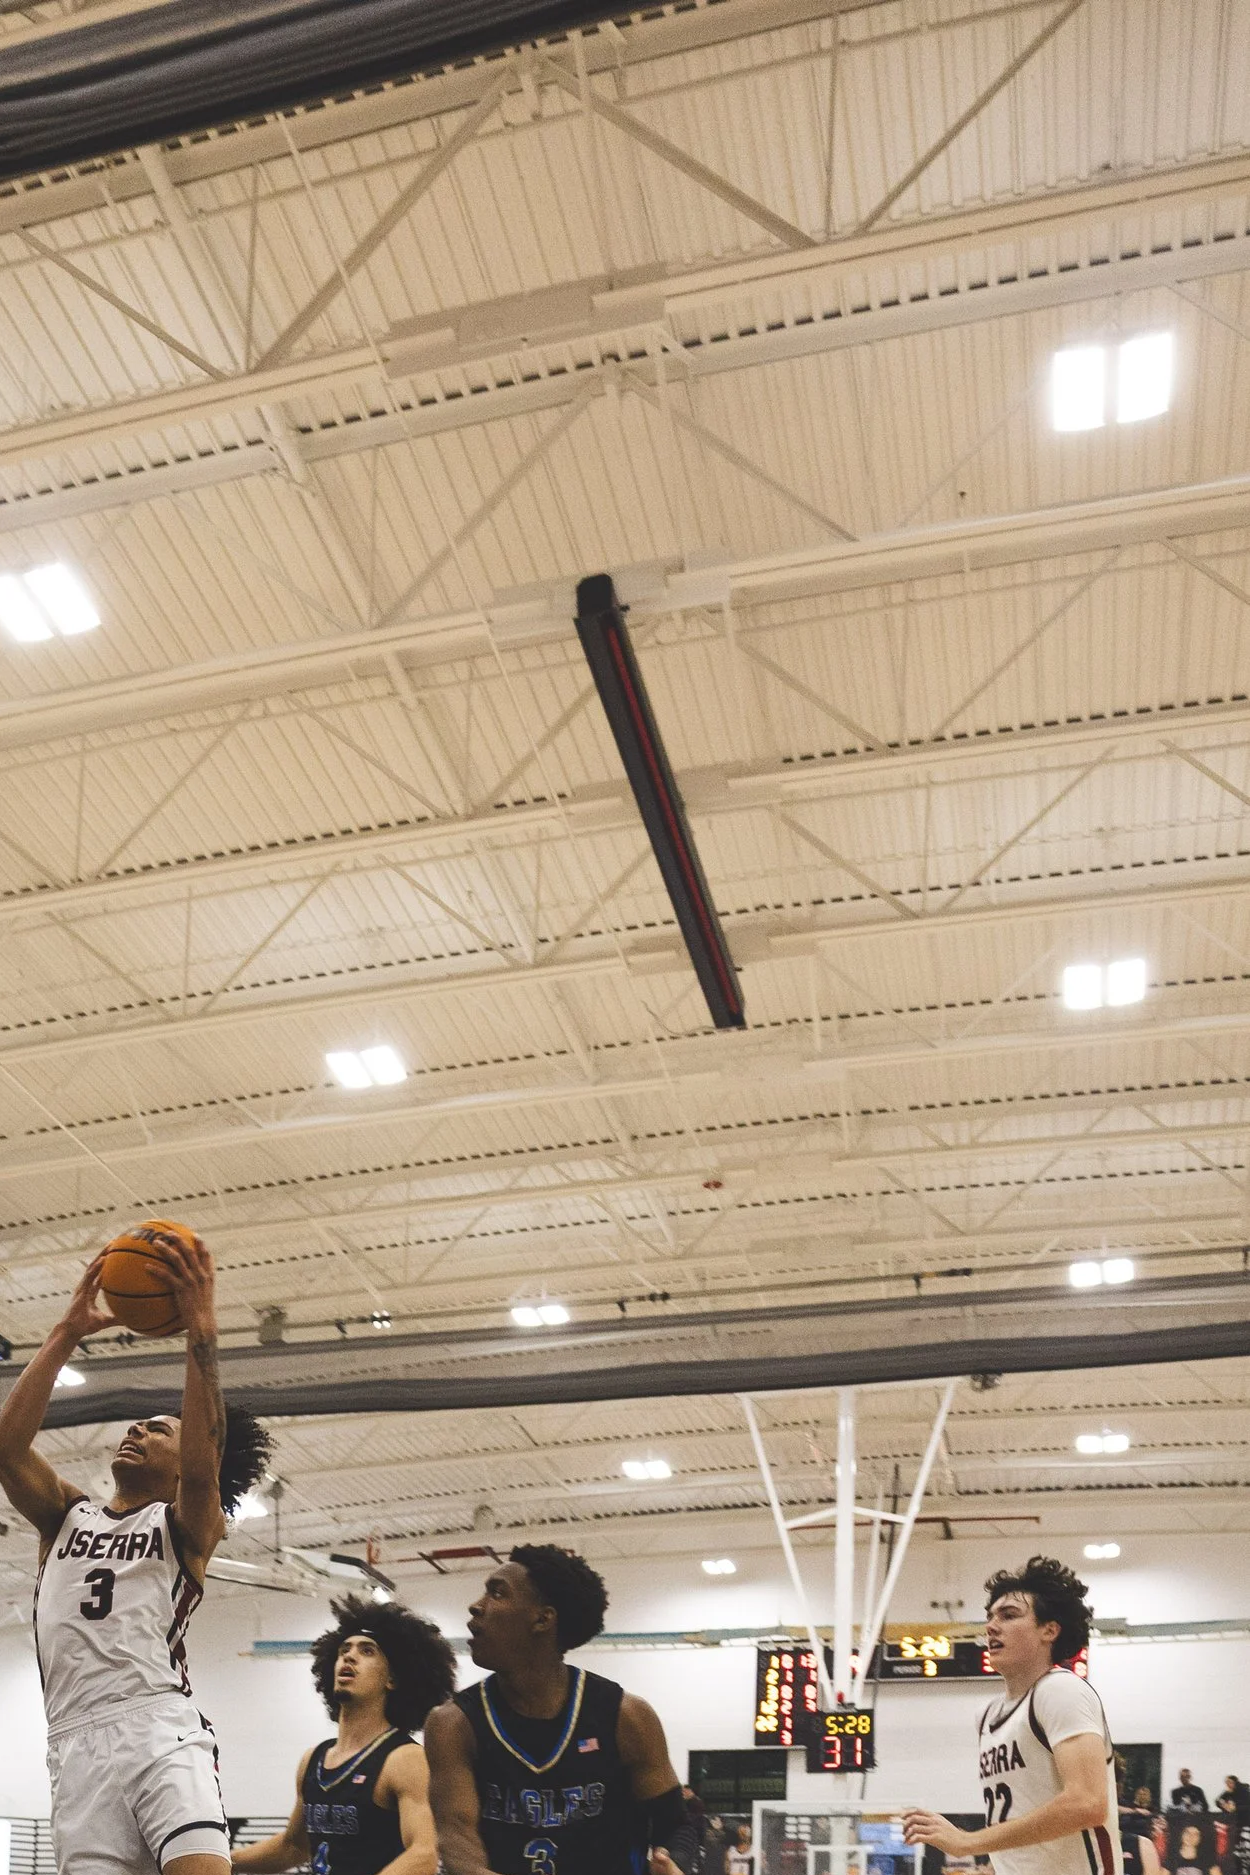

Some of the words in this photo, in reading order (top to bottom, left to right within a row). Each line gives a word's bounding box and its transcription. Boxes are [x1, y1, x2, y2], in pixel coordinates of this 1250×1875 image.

[57, 1526, 165, 1561] JSERRA
[80, 1568, 116, 1621] 3
[825, 1714, 871, 1735] 5:28
[822, 1735, 863, 1769] 31
[483, 1781, 607, 1828] EAGLES
